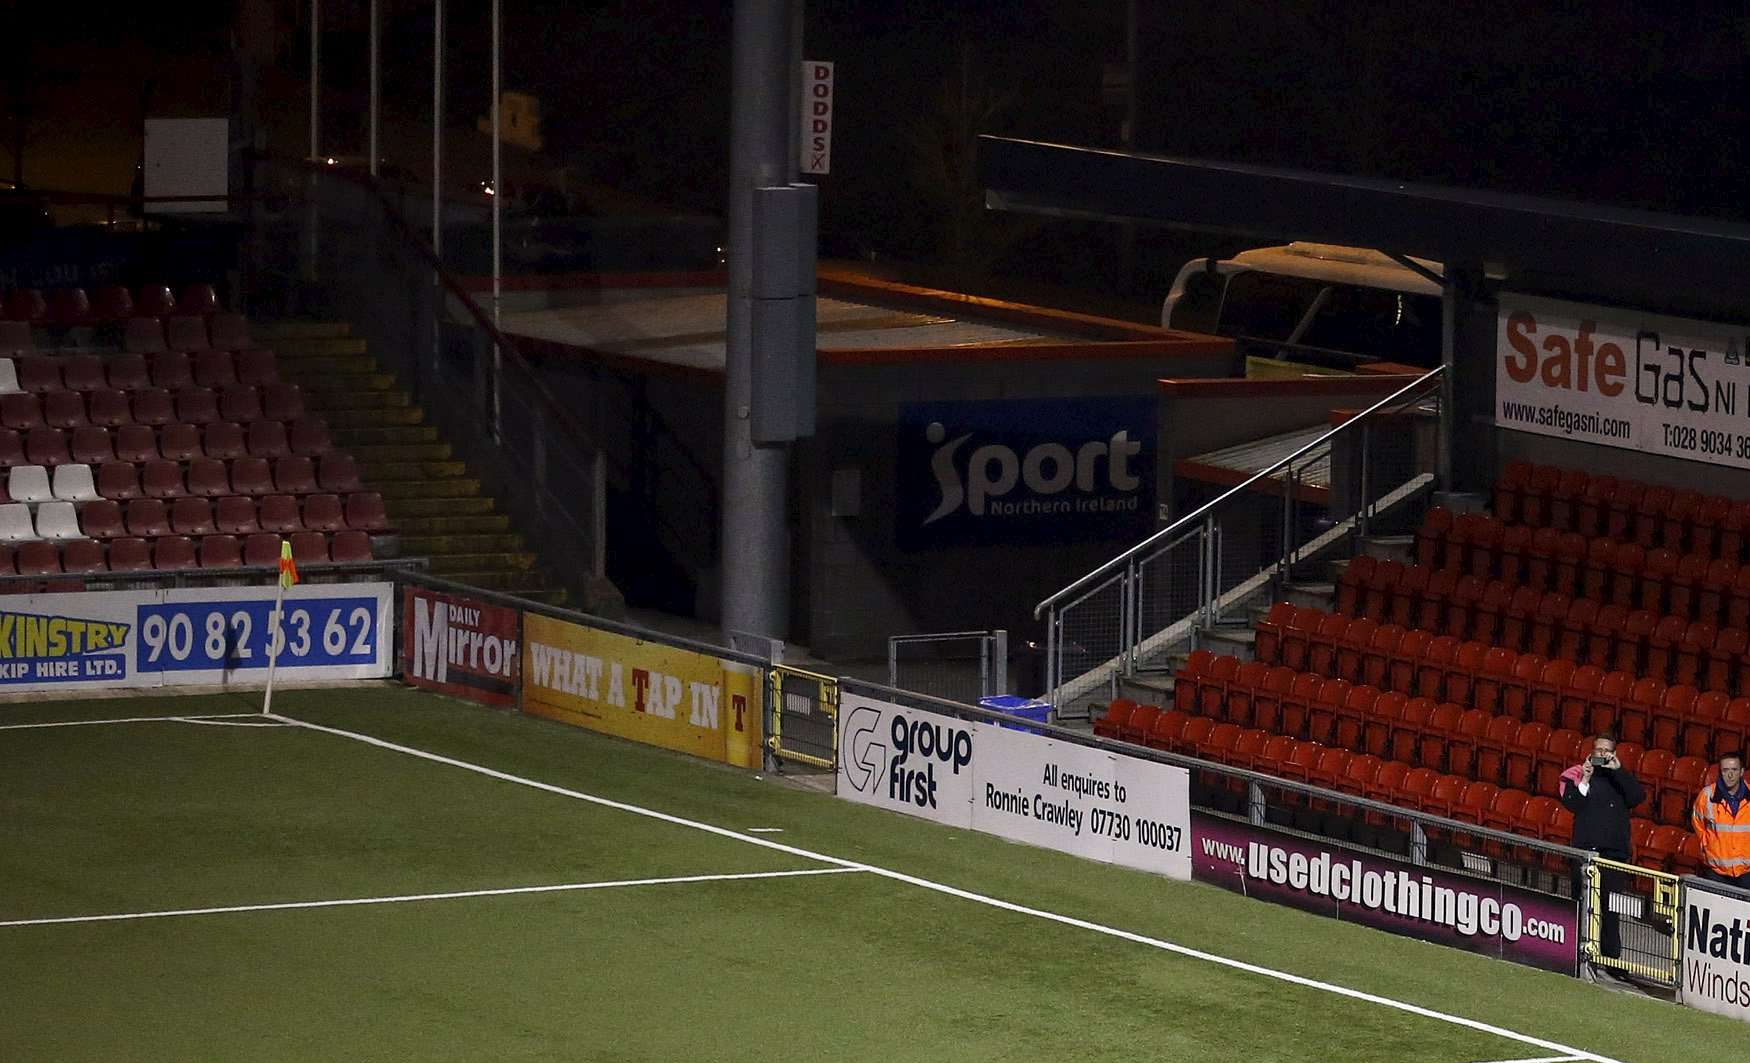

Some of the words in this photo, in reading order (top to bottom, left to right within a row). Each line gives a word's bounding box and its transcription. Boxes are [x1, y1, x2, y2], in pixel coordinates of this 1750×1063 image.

[1504, 309, 1627, 398] Safe
[1715, 379, 1736, 416] NI
[1502, 401, 1631, 440] www.safegasni.com
[1662, 423, 1697, 450] T:028
[1701, 430, 1733, 457] 9034
[990, 498, 1074, 516] Northern
[1075, 496, 1139, 514] Ireland
[143, 612, 194, 662] 90
[205, 610, 253, 660] 82
[265, 608, 311, 658] 53
[323, 607, 372, 656] 62
[413, 596, 517, 684] Mirror
[449, 604, 481, 627] DAILY
[36, 660, 79, 678] HIRE
[85, 659, 122, 677] LTD.
[529, 641, 602, 701] WHAT
[607, 661, 625, 708] A
[632, 667, 683, 720] TAP
[688, 681, 721, 730] IN
[732, 694, 746, 732] T
[891, 714, 972, 775] group
[889, 755, 937, 810] first
[1043, 763, 1058, 788] All
[1061, 769, 1110, 802] enquires
[1113, 781, 1127, 804] to
[986, 782, 1029, 817] Ronnie
[1033, 794, 1084, 836] Crawley
[1090, 808, 1131, 841] 07730
[1135, 818, 1183, 853] 100037
[1201, 834, 1566, 942] www.usedclothingco.com
